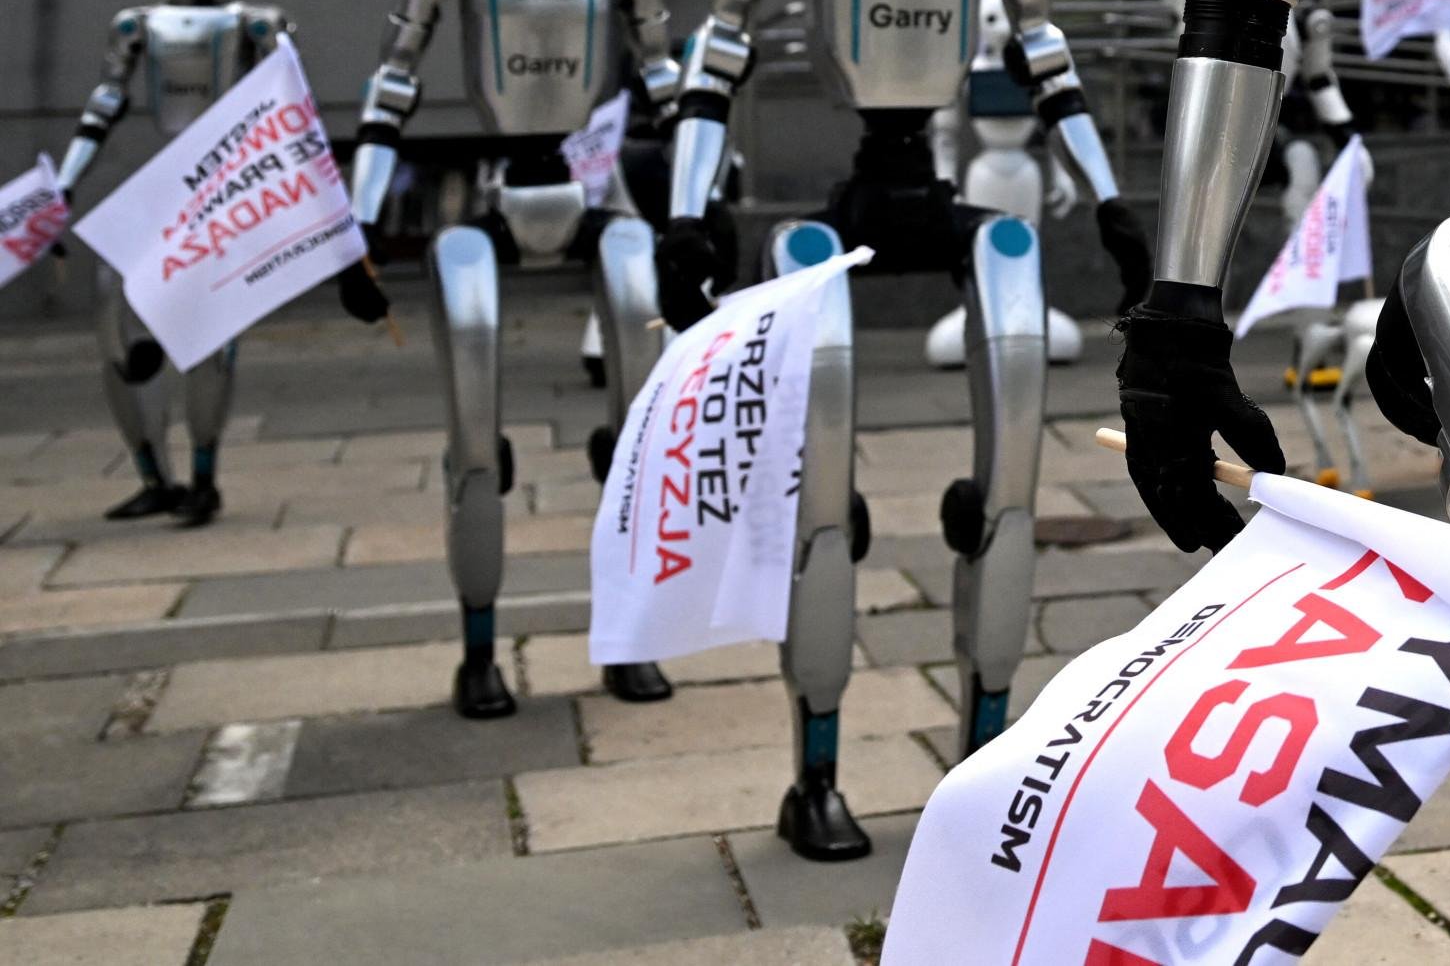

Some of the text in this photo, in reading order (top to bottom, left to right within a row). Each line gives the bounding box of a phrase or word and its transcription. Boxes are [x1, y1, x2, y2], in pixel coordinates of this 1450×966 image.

[507, 53, 581, 79] Garry
[869, 2, 953, 35] Garry
[697, 364, 740, 527] TO TEŻ
[990, 603, 1227, 874] DEMOCRATISM
